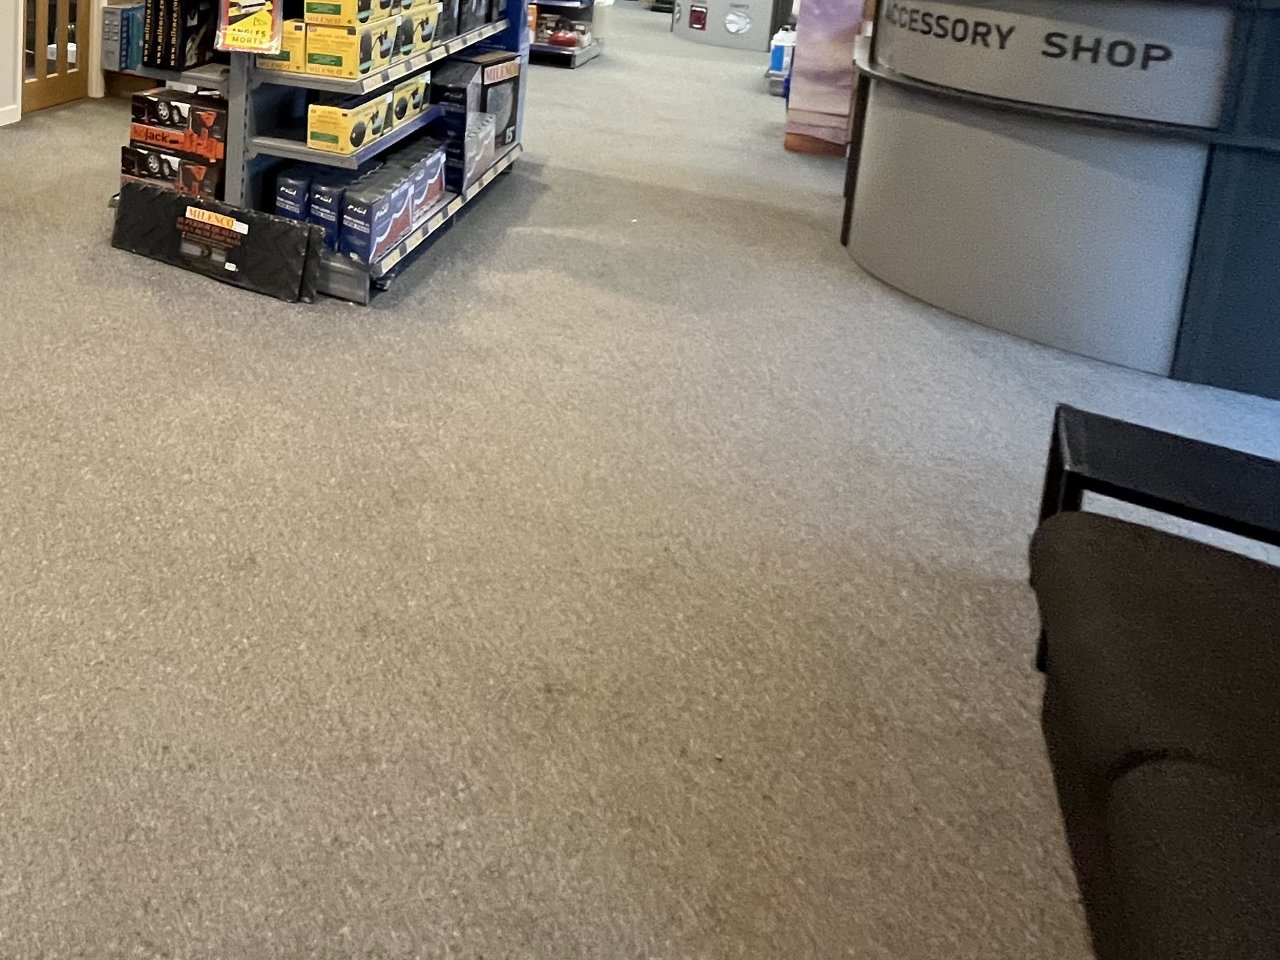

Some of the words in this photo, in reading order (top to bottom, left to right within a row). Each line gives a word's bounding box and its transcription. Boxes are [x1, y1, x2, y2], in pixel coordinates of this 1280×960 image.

[232, 35, 265, 45] MORTS
[1041, 31, 1174, 71] SHOP
[188, 207, 234, 229] MILENCO
